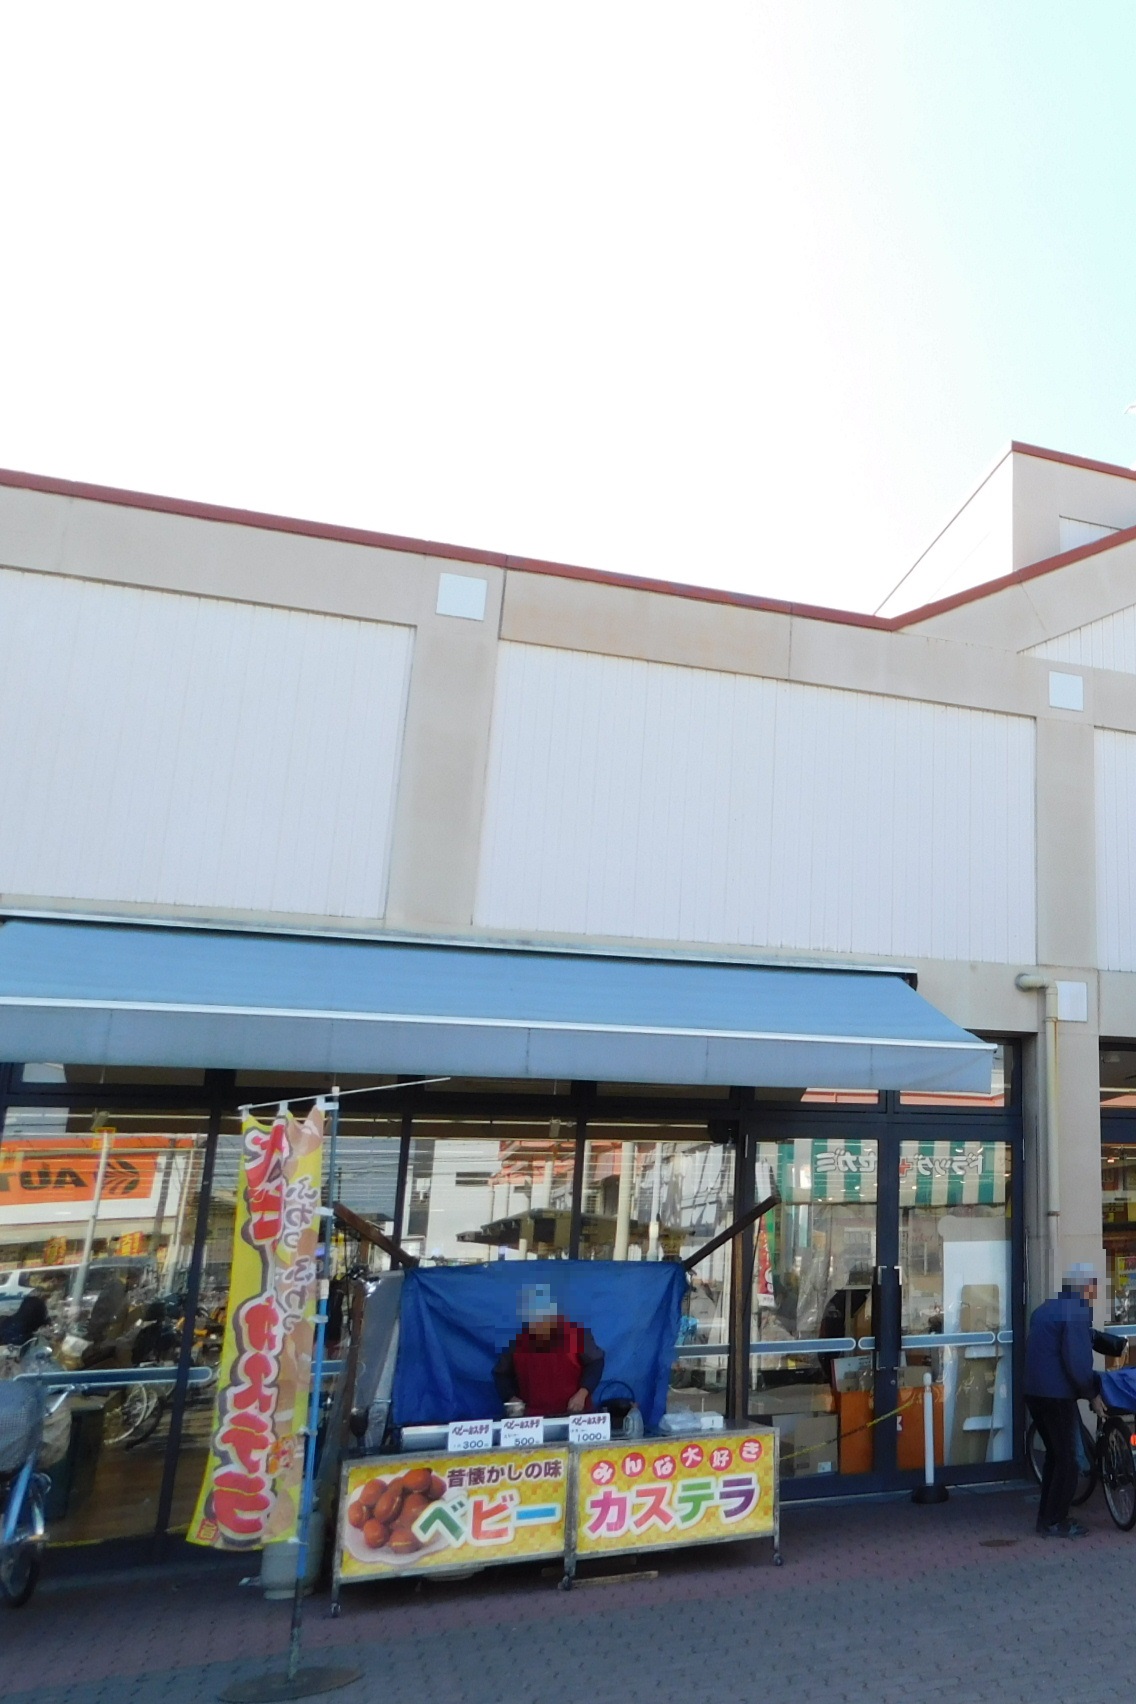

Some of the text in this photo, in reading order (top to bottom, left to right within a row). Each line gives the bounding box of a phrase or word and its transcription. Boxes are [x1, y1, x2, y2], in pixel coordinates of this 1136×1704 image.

[447, 1459, 562, 1488] 昔懐かしの味
[592, 1440, 761, 1484] みんな大好き
[415, 1492, 559, 1543] ベビー
[588, 1475, 757, 1536] カステラ
